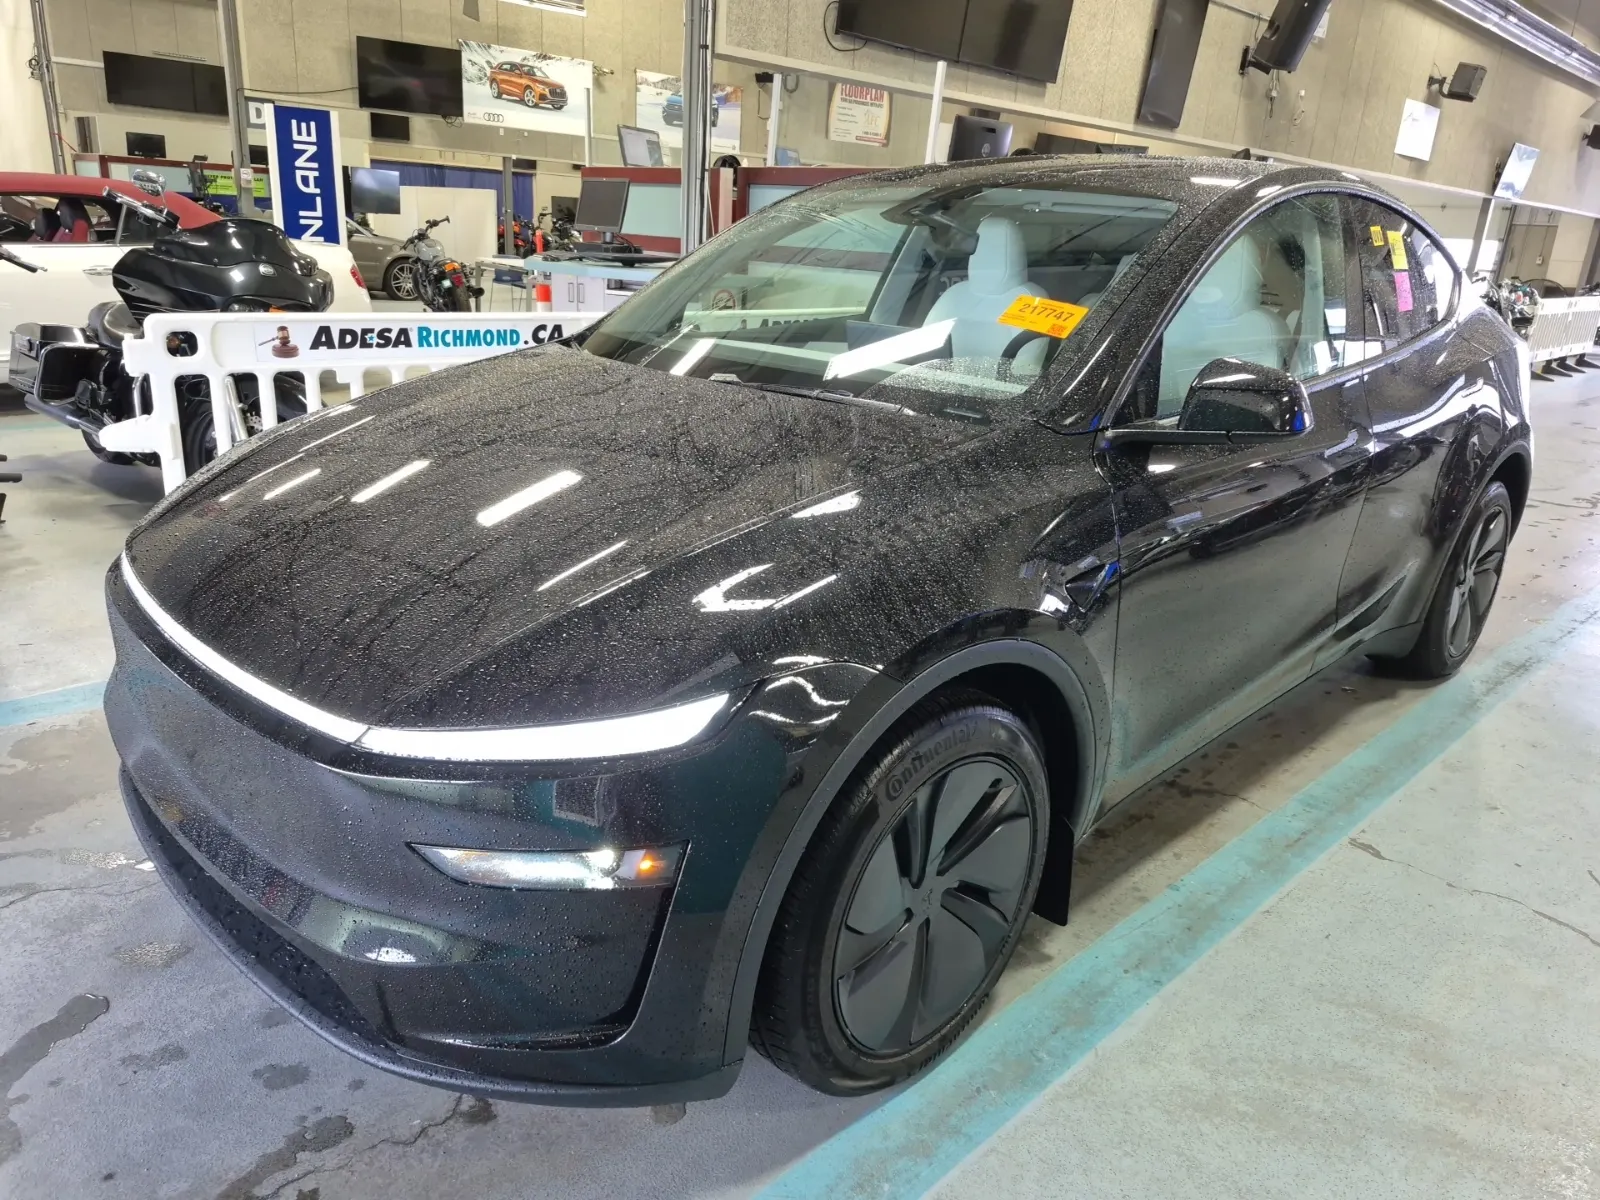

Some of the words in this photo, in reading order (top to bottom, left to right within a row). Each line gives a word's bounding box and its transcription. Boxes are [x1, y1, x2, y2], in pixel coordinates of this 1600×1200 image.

[248, 101, 266, 124] D
[291, 119, 325, 242] NLANE
[1018, 303, 1076, 322] 217747
[309, 325, 413, 350] ADESA
[885, 722, 973, 801] Continental
